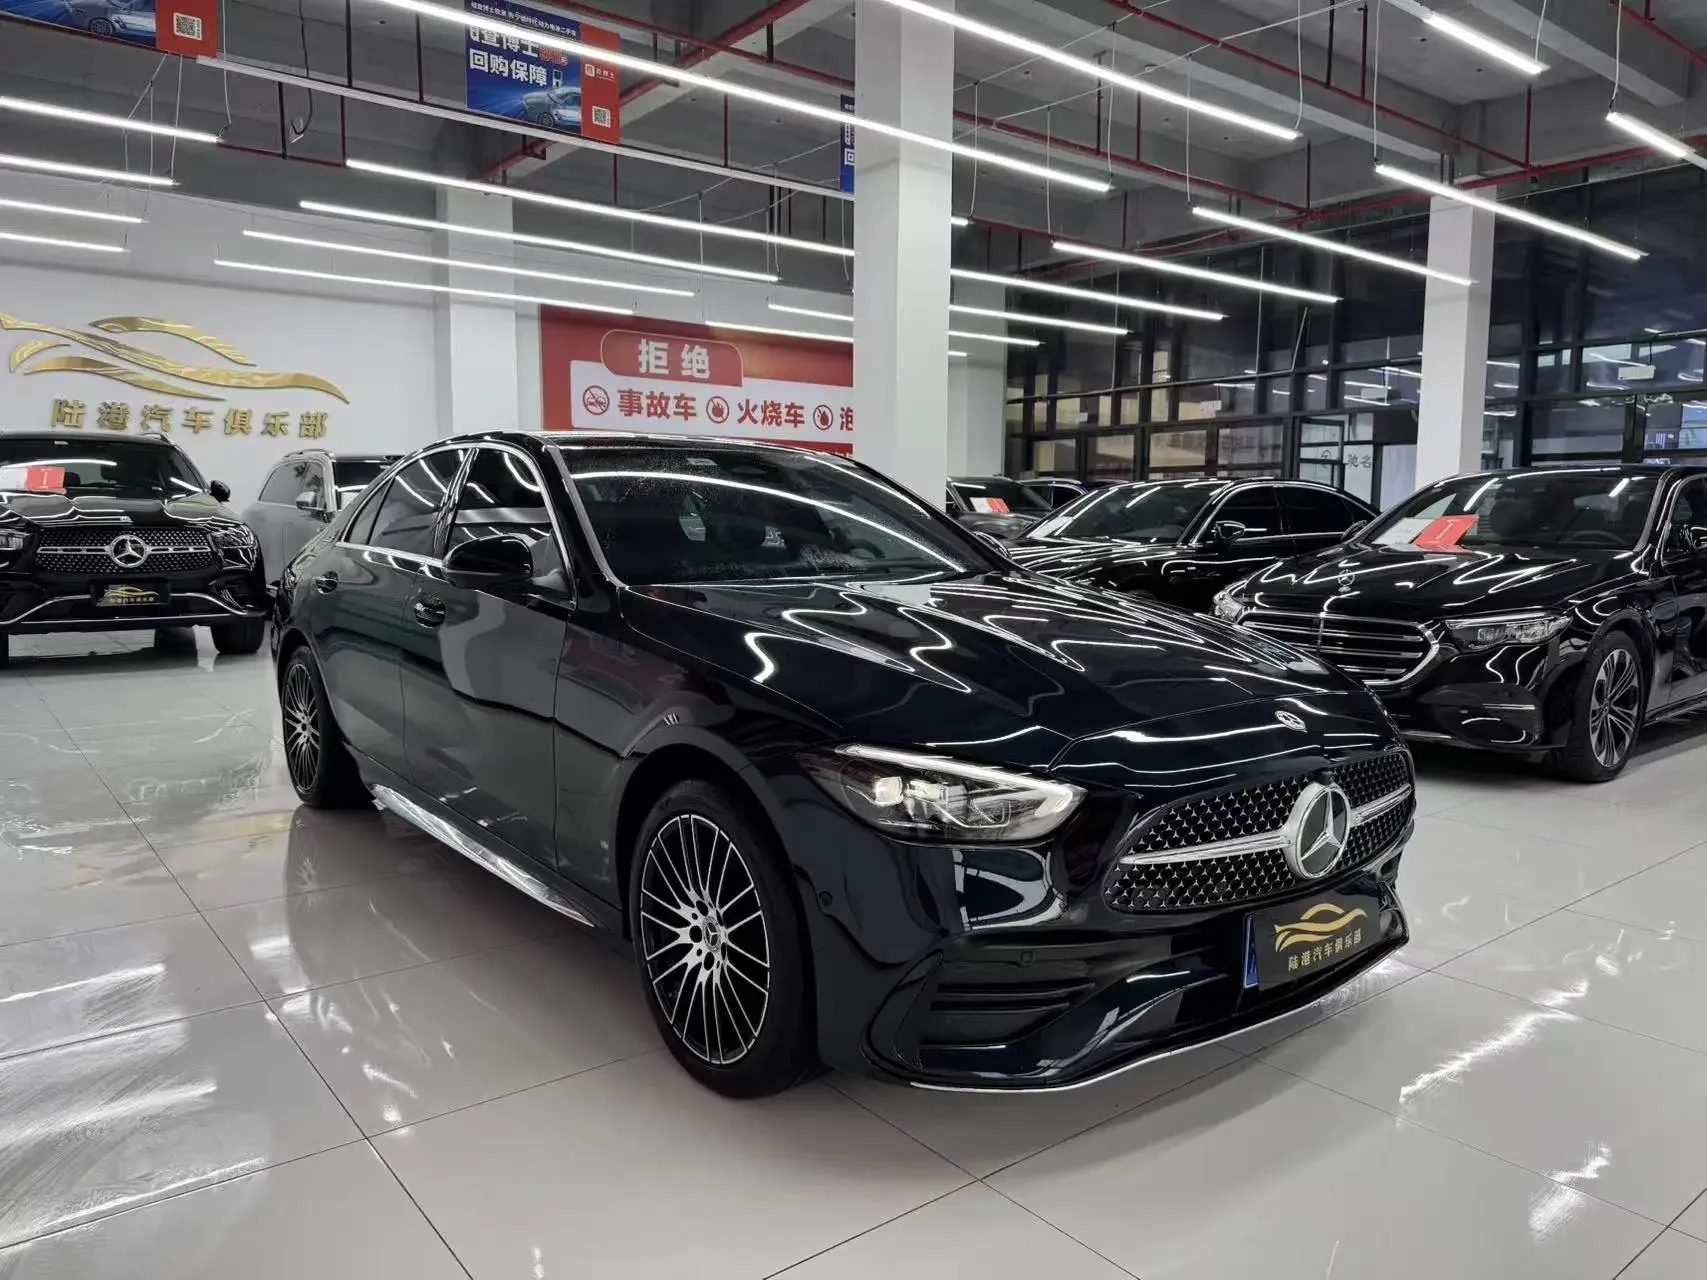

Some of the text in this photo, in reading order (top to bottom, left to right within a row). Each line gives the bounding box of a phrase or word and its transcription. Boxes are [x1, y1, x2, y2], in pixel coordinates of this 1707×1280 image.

[469, 48, 548, 87] 回购保障
[638, 338, 711, 380] 拒绝
[50, 398, 329, 440] 陆港汽车俱乐部
[617, 388, 698, 422] 事故车
[736, 398, 805, 428] 火烧车
[1287, 928, 1363, 972] 陆港汽车俱乐部
